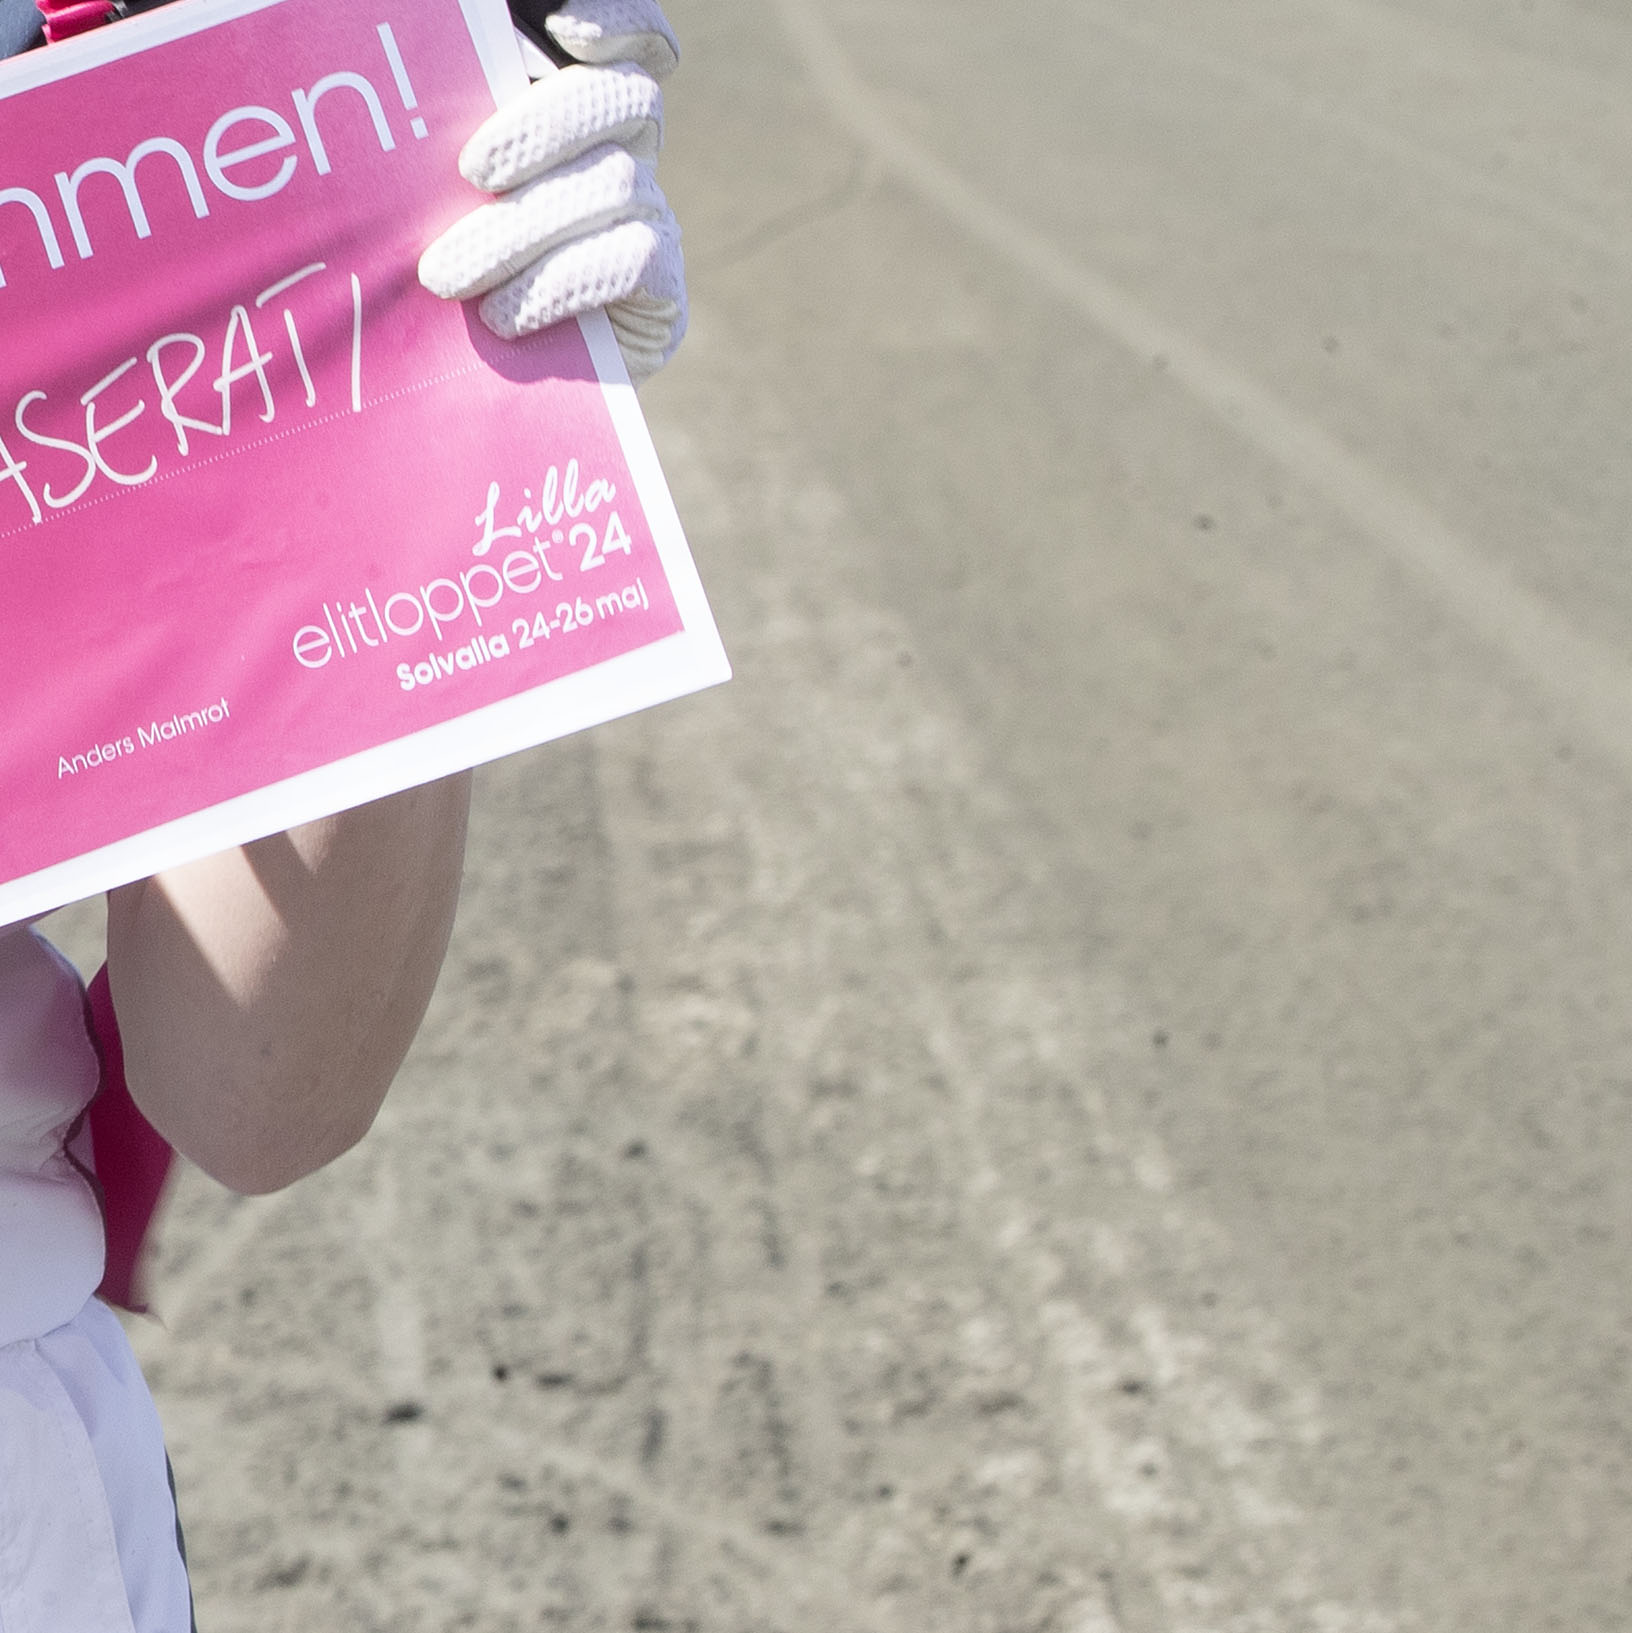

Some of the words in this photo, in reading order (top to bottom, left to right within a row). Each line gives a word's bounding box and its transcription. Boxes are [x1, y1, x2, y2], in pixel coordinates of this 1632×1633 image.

[472, 458, 617, 556] Lilla
[396, 634, 511, 691] Solvalla
[512, 597, 594, 649] 24-26
[596, 577, 650, 620] maj
[57, 736, 135, 780] Anders
[137, 697, 231, 749] Malmrot
